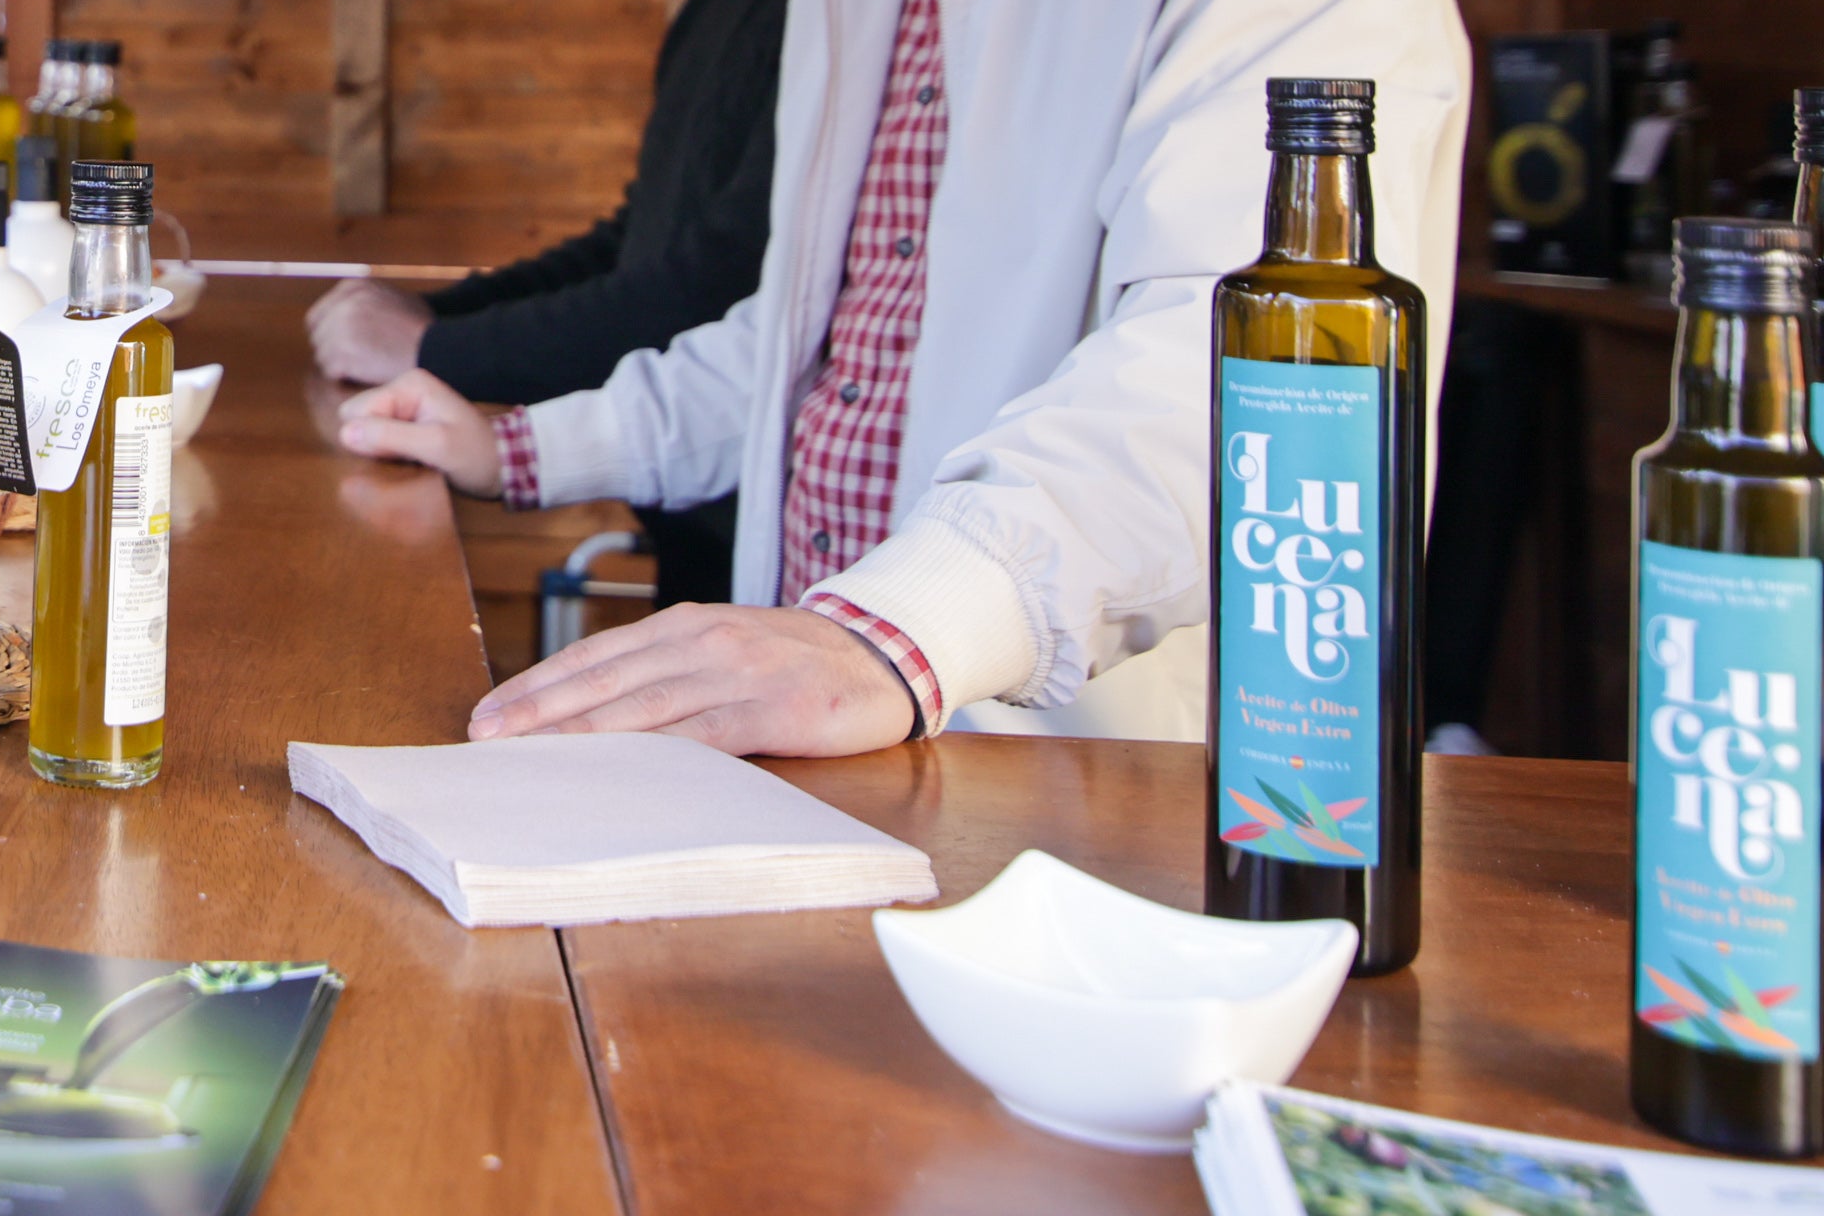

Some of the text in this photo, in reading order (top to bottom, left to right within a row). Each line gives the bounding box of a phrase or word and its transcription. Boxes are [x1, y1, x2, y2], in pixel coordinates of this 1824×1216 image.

[55, 423, 85, 451] Los
[75, 361, 102, 418] Omeya
[1229, 381, 1370, 403] Denominación de Origen
[1239, 396, 1354, 415] Protegida Aceite de
[140, 438, 149, 475] 927333
[119, 538, 153, 547] INFORMACIÓN
[1236, 685, 1360, 718] Aceite de Oliva
[1241, 707, 1352, 740] Virgen Extra
